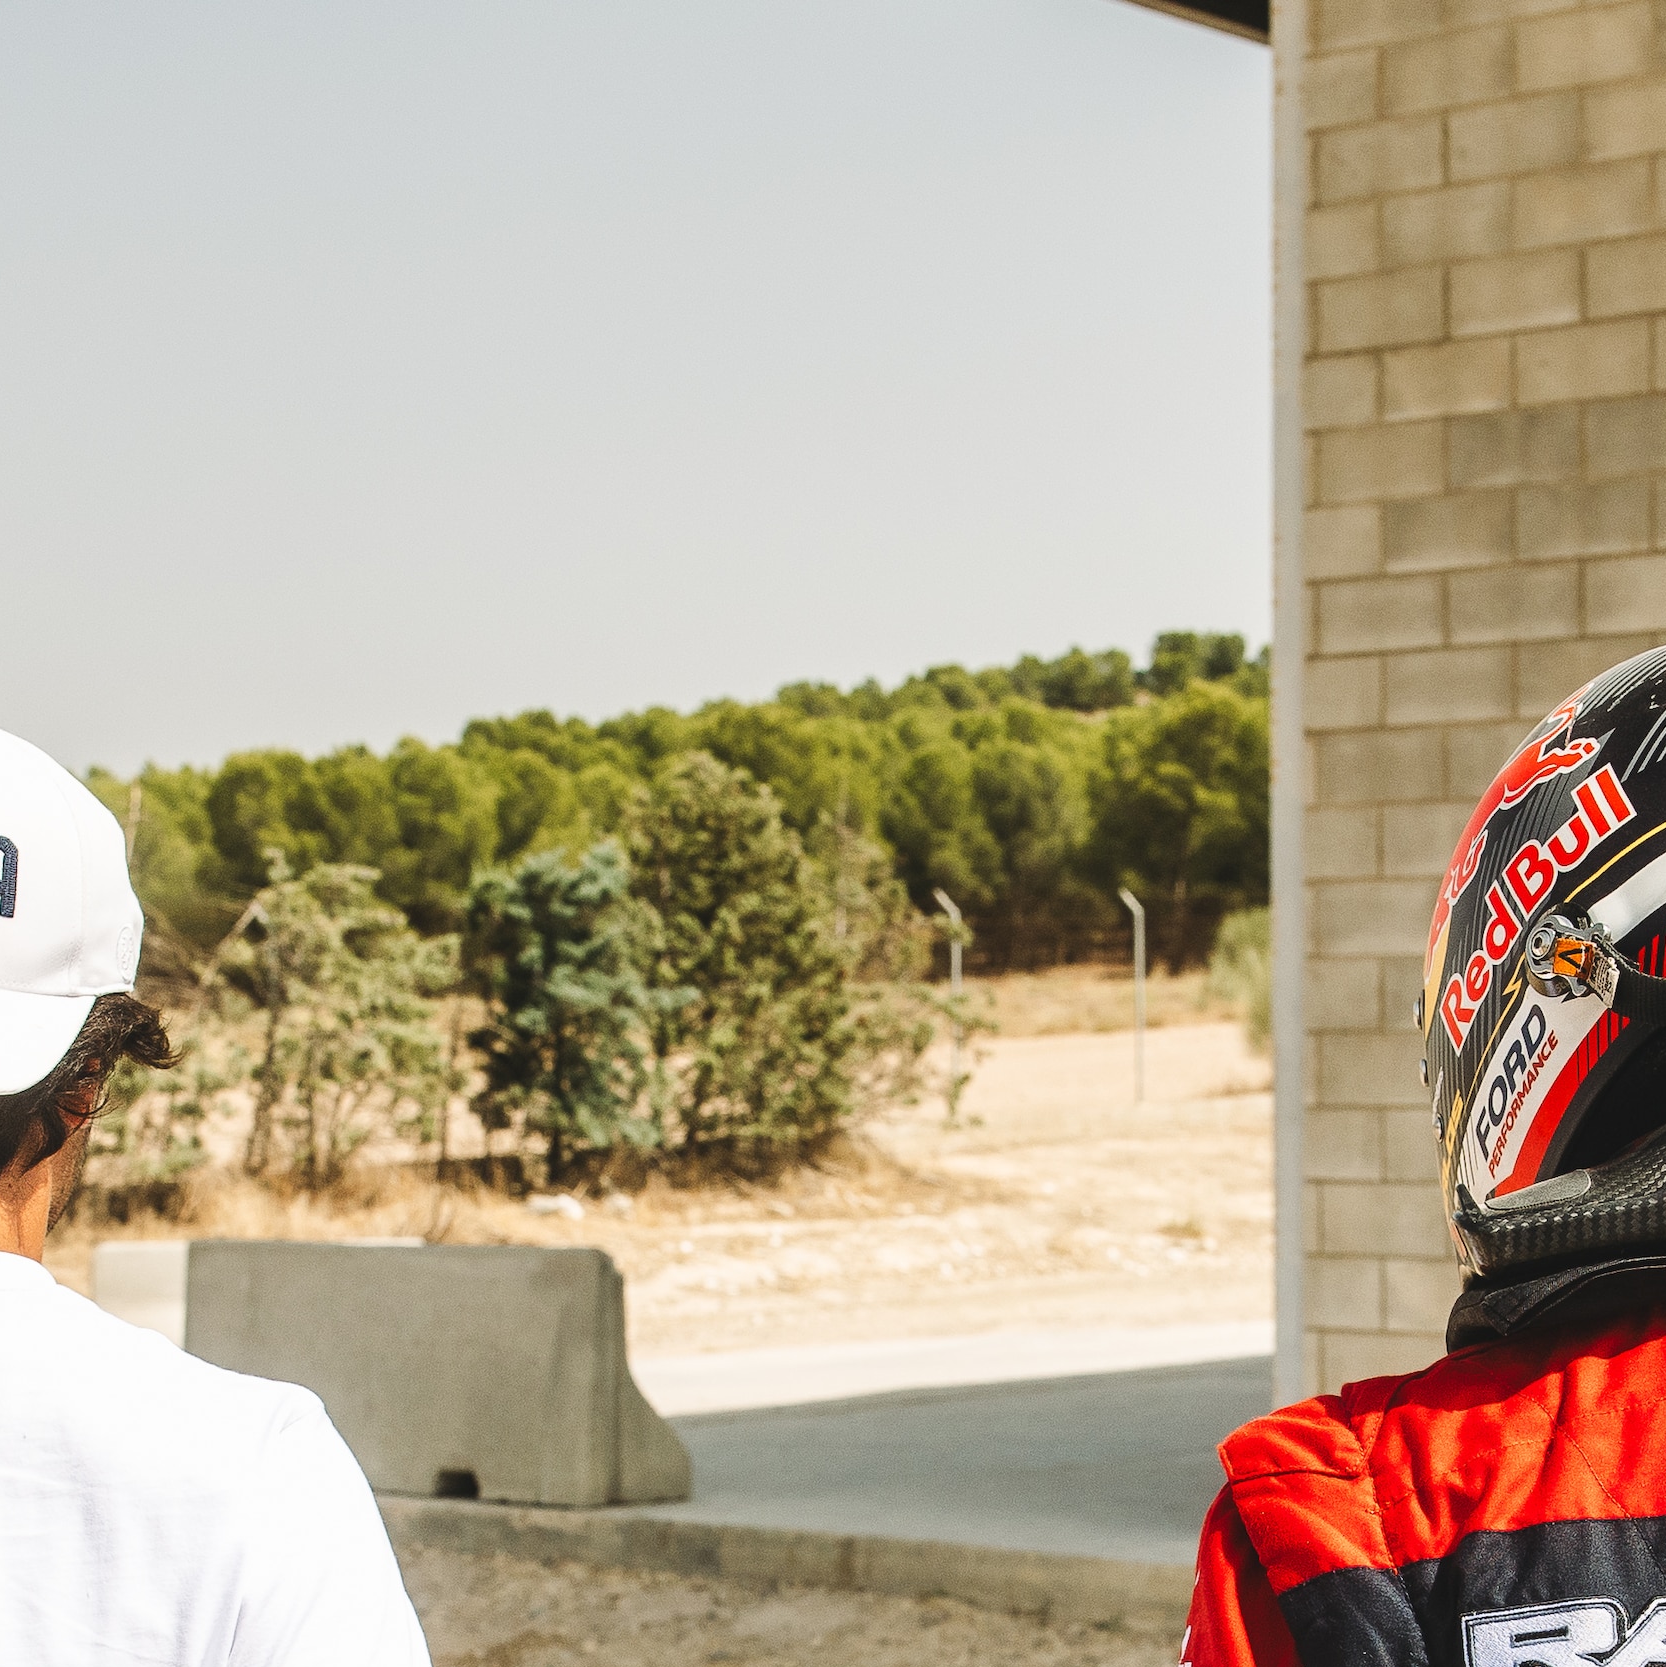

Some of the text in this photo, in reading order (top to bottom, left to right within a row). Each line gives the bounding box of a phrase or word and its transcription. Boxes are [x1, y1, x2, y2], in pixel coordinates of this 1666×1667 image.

[1440, 763, 1637, 1057] Red Bull
[1475, 1004, 1546, 1162] FORD
[1488, 1030, 1559, 1179] PERFORMANCE
